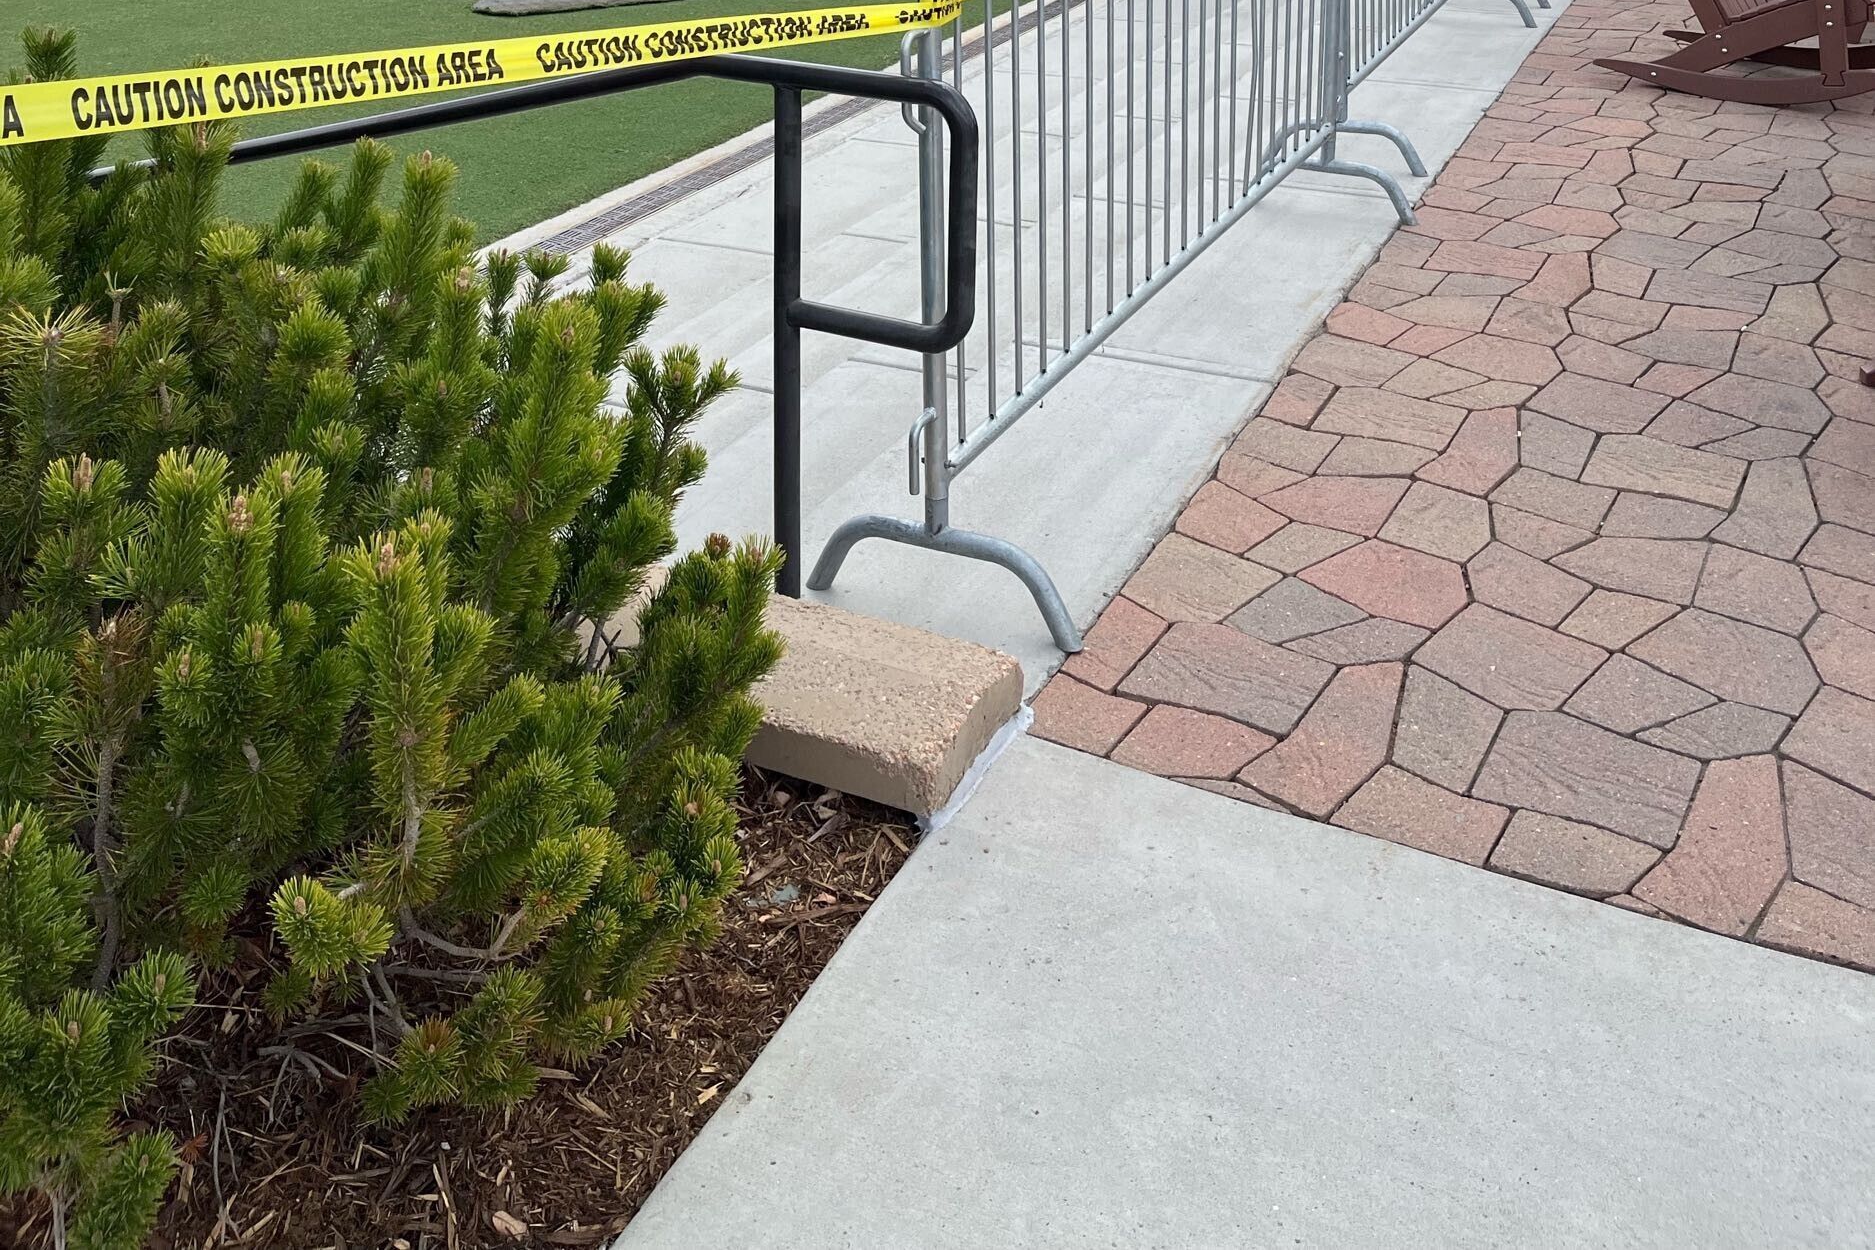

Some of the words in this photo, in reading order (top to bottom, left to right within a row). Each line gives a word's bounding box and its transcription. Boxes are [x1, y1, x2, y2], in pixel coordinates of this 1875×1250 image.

[536, 34, 643, 73] CAUTION
[644, 15, 812, 59] CONSTRUCTION
[816, 12, 870, 36] AREA
[71, 77, 207, 131] CAUTION
[214, 55, 430, 114] CONSTRUCTION
[437, 49, 504, 87] AREA
